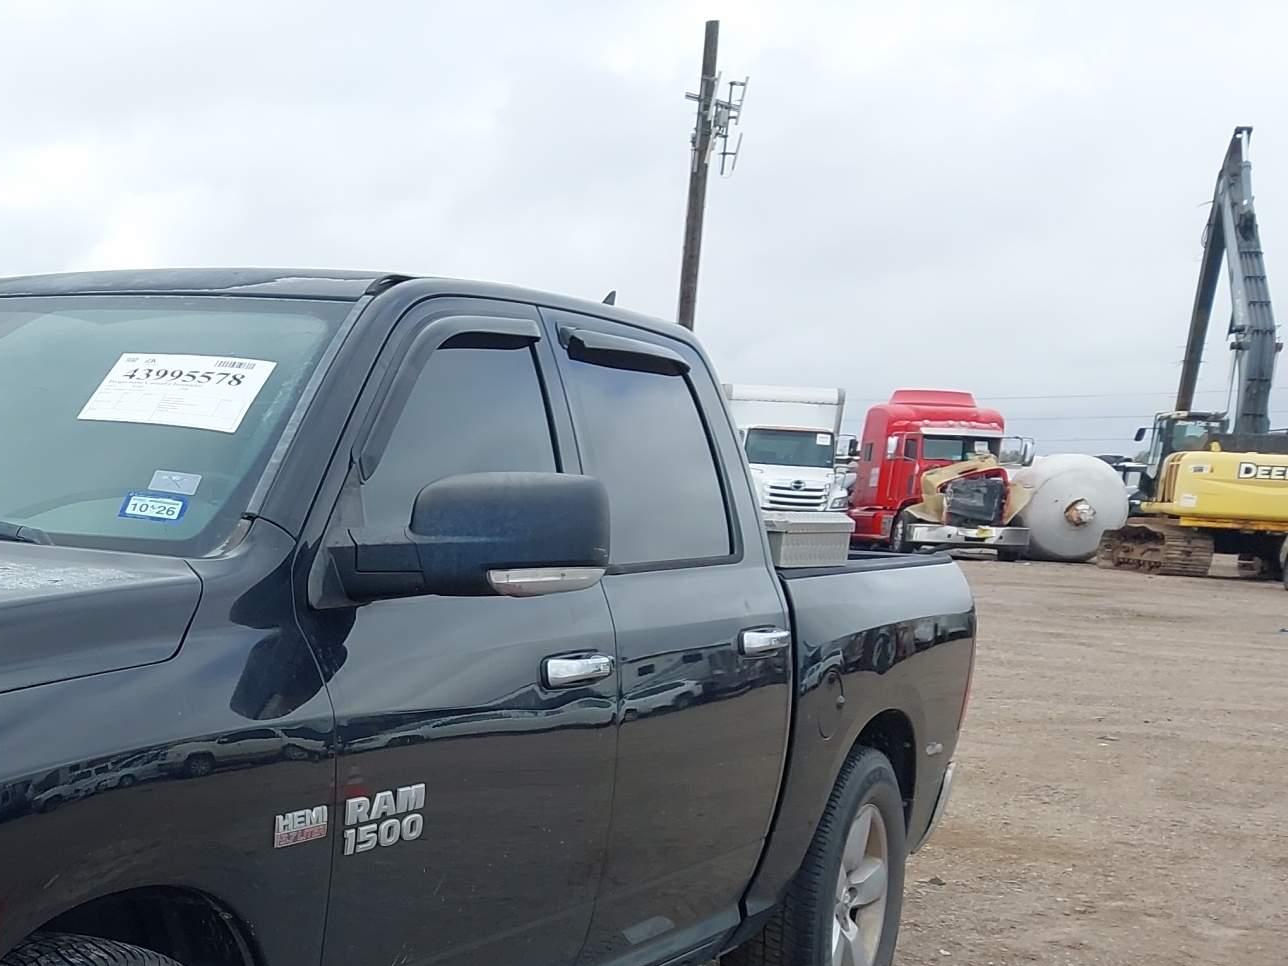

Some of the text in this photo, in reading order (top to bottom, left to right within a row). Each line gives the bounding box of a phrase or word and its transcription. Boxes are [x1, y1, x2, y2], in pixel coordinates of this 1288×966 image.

[122, 367, 246, 386] 43995578
[1239, 461, 1288, 481] DEE
[130, 503, 177, 516] 10 26
[345, 783, 426, 825] RAM
[275, 805, 328, 832] HEMI
[344, 813, 424, 856] 1500
